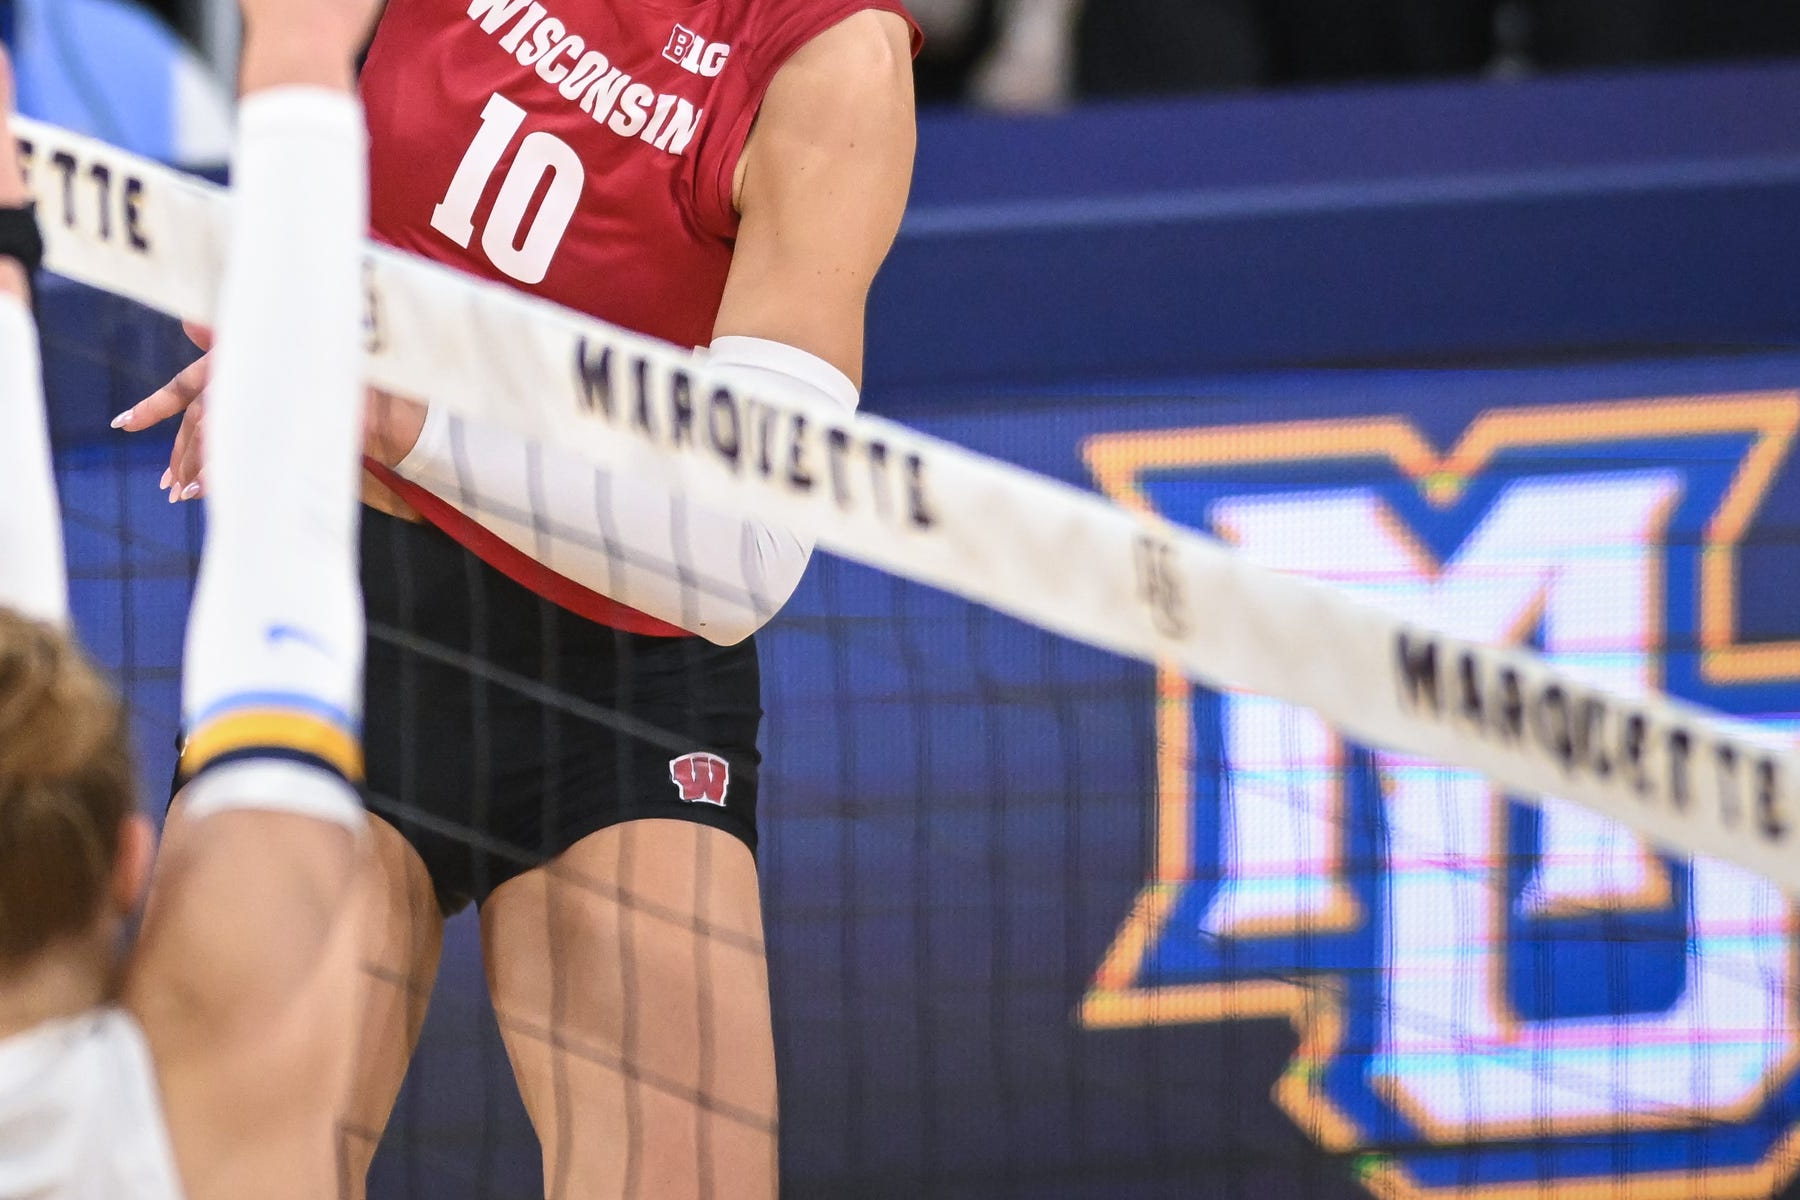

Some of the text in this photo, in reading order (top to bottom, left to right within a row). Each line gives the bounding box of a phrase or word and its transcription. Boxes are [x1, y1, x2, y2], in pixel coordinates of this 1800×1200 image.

[430, 91, 585, 286] 10
[668, 751, 730, 807] W
[1392, 627, 1790, 842] MARQUETTE
